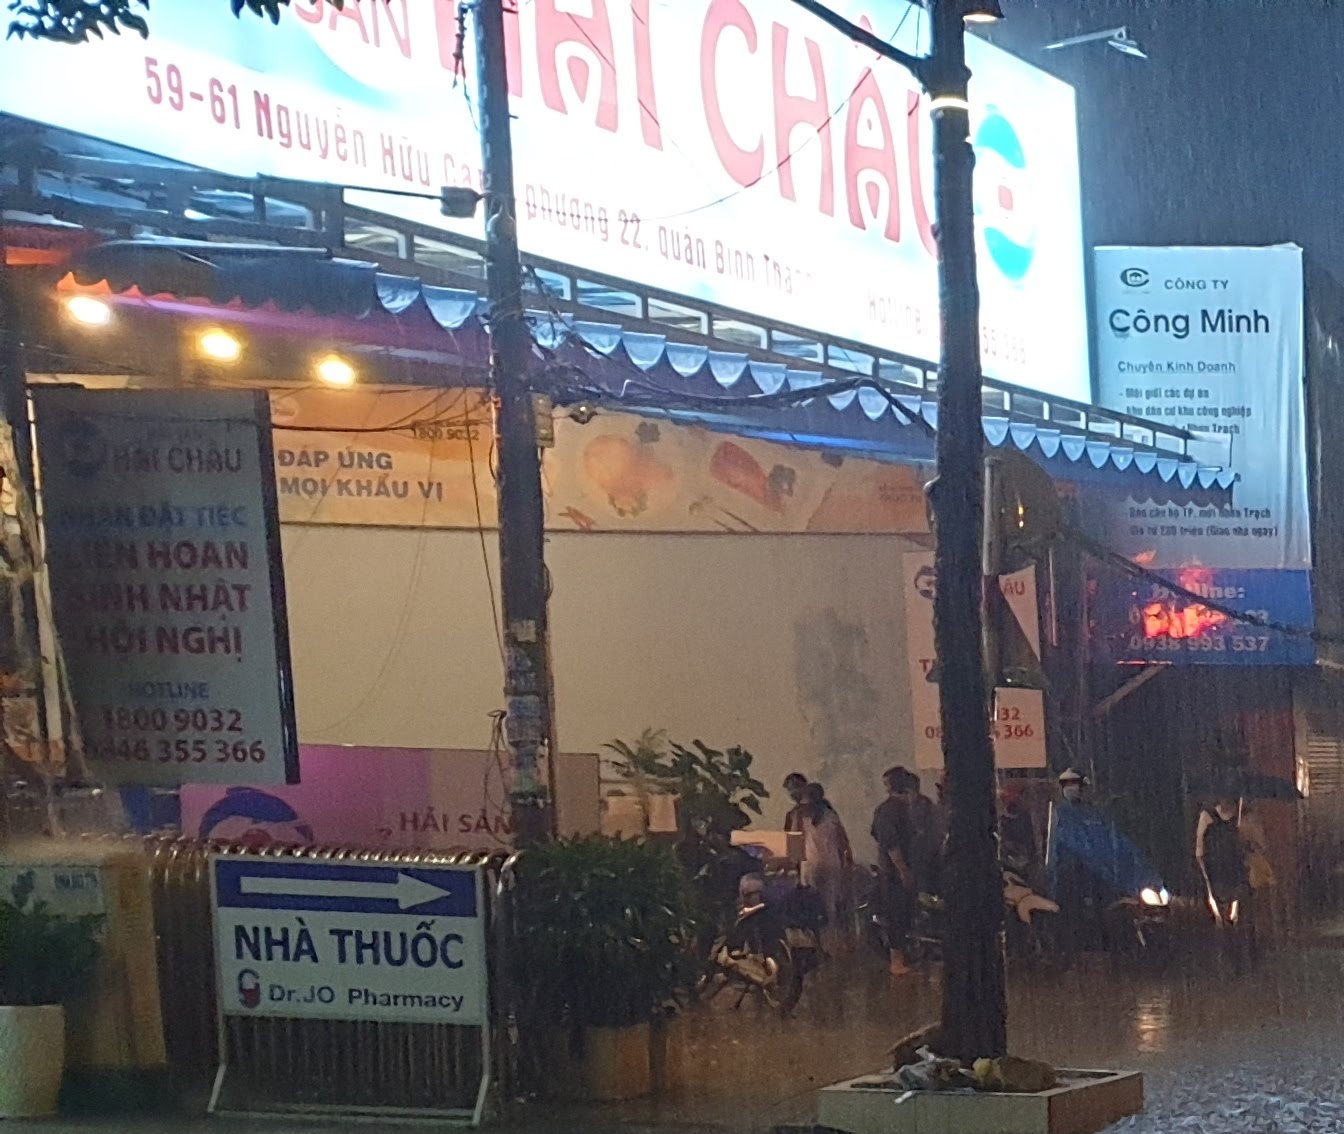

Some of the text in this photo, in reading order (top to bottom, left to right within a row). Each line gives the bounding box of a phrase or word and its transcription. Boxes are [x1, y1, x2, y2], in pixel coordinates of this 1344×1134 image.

[145, 56, 240, 130] 59-61
[1164, 277, 1207, 290] CÔNG
[1211, 279, 1229, 290] TY
[1108, 307, 1270, 340] Công Minh
[1117, 360, 1236, 374] Chuyên Kinh Doanh
[156, 625, 243, 663] NGHỊ
[1231, 636, 1271, 652] 537
[174, 708, 244, 733] 9032
[1003, 723, 1034, 740] 366
[158, 740, 208, 763] 355
[214, 740, 266, 763] 366
[399, 805, 449, 833] HẢI
[234, 916, 465, 970] NHÀ THUỐC
[268, 983, 465, 1013] Dr.JO Pharmacy
